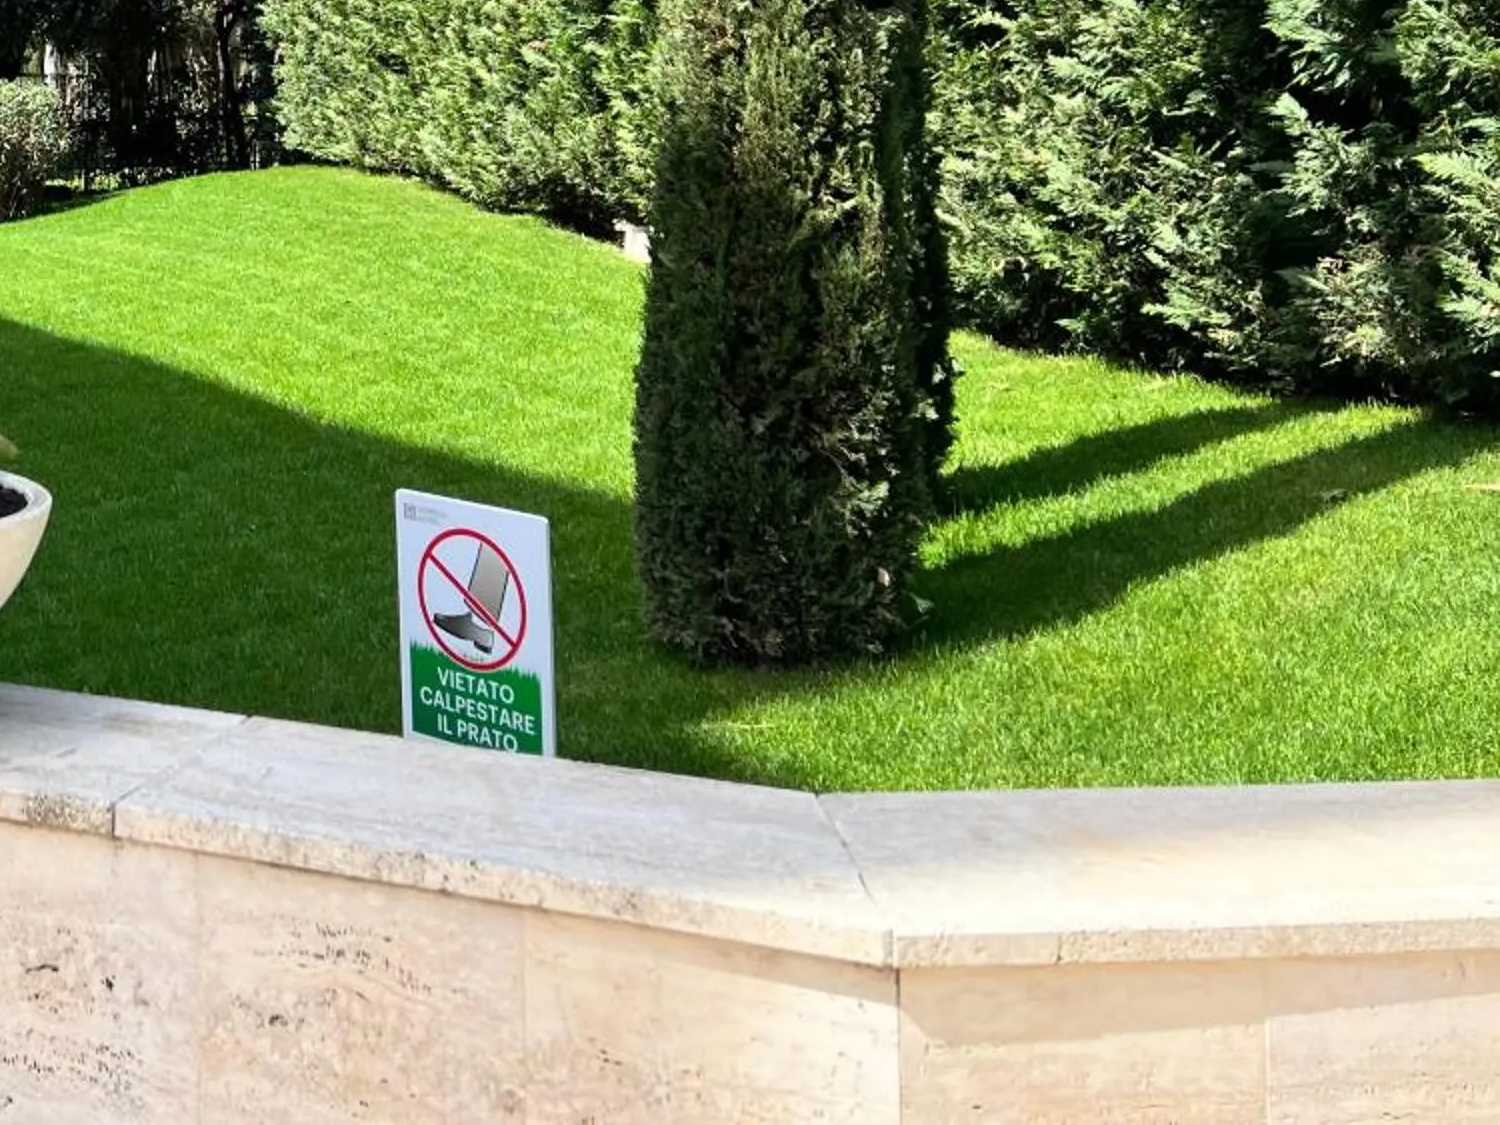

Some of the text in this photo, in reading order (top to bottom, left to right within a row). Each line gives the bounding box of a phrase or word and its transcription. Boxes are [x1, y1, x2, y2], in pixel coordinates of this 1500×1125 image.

[437, 666, 515, 704] VIETATO
[420, 686, 536, 736] CALPESTARE
[437, 713, 519, 753] IL PRATO
